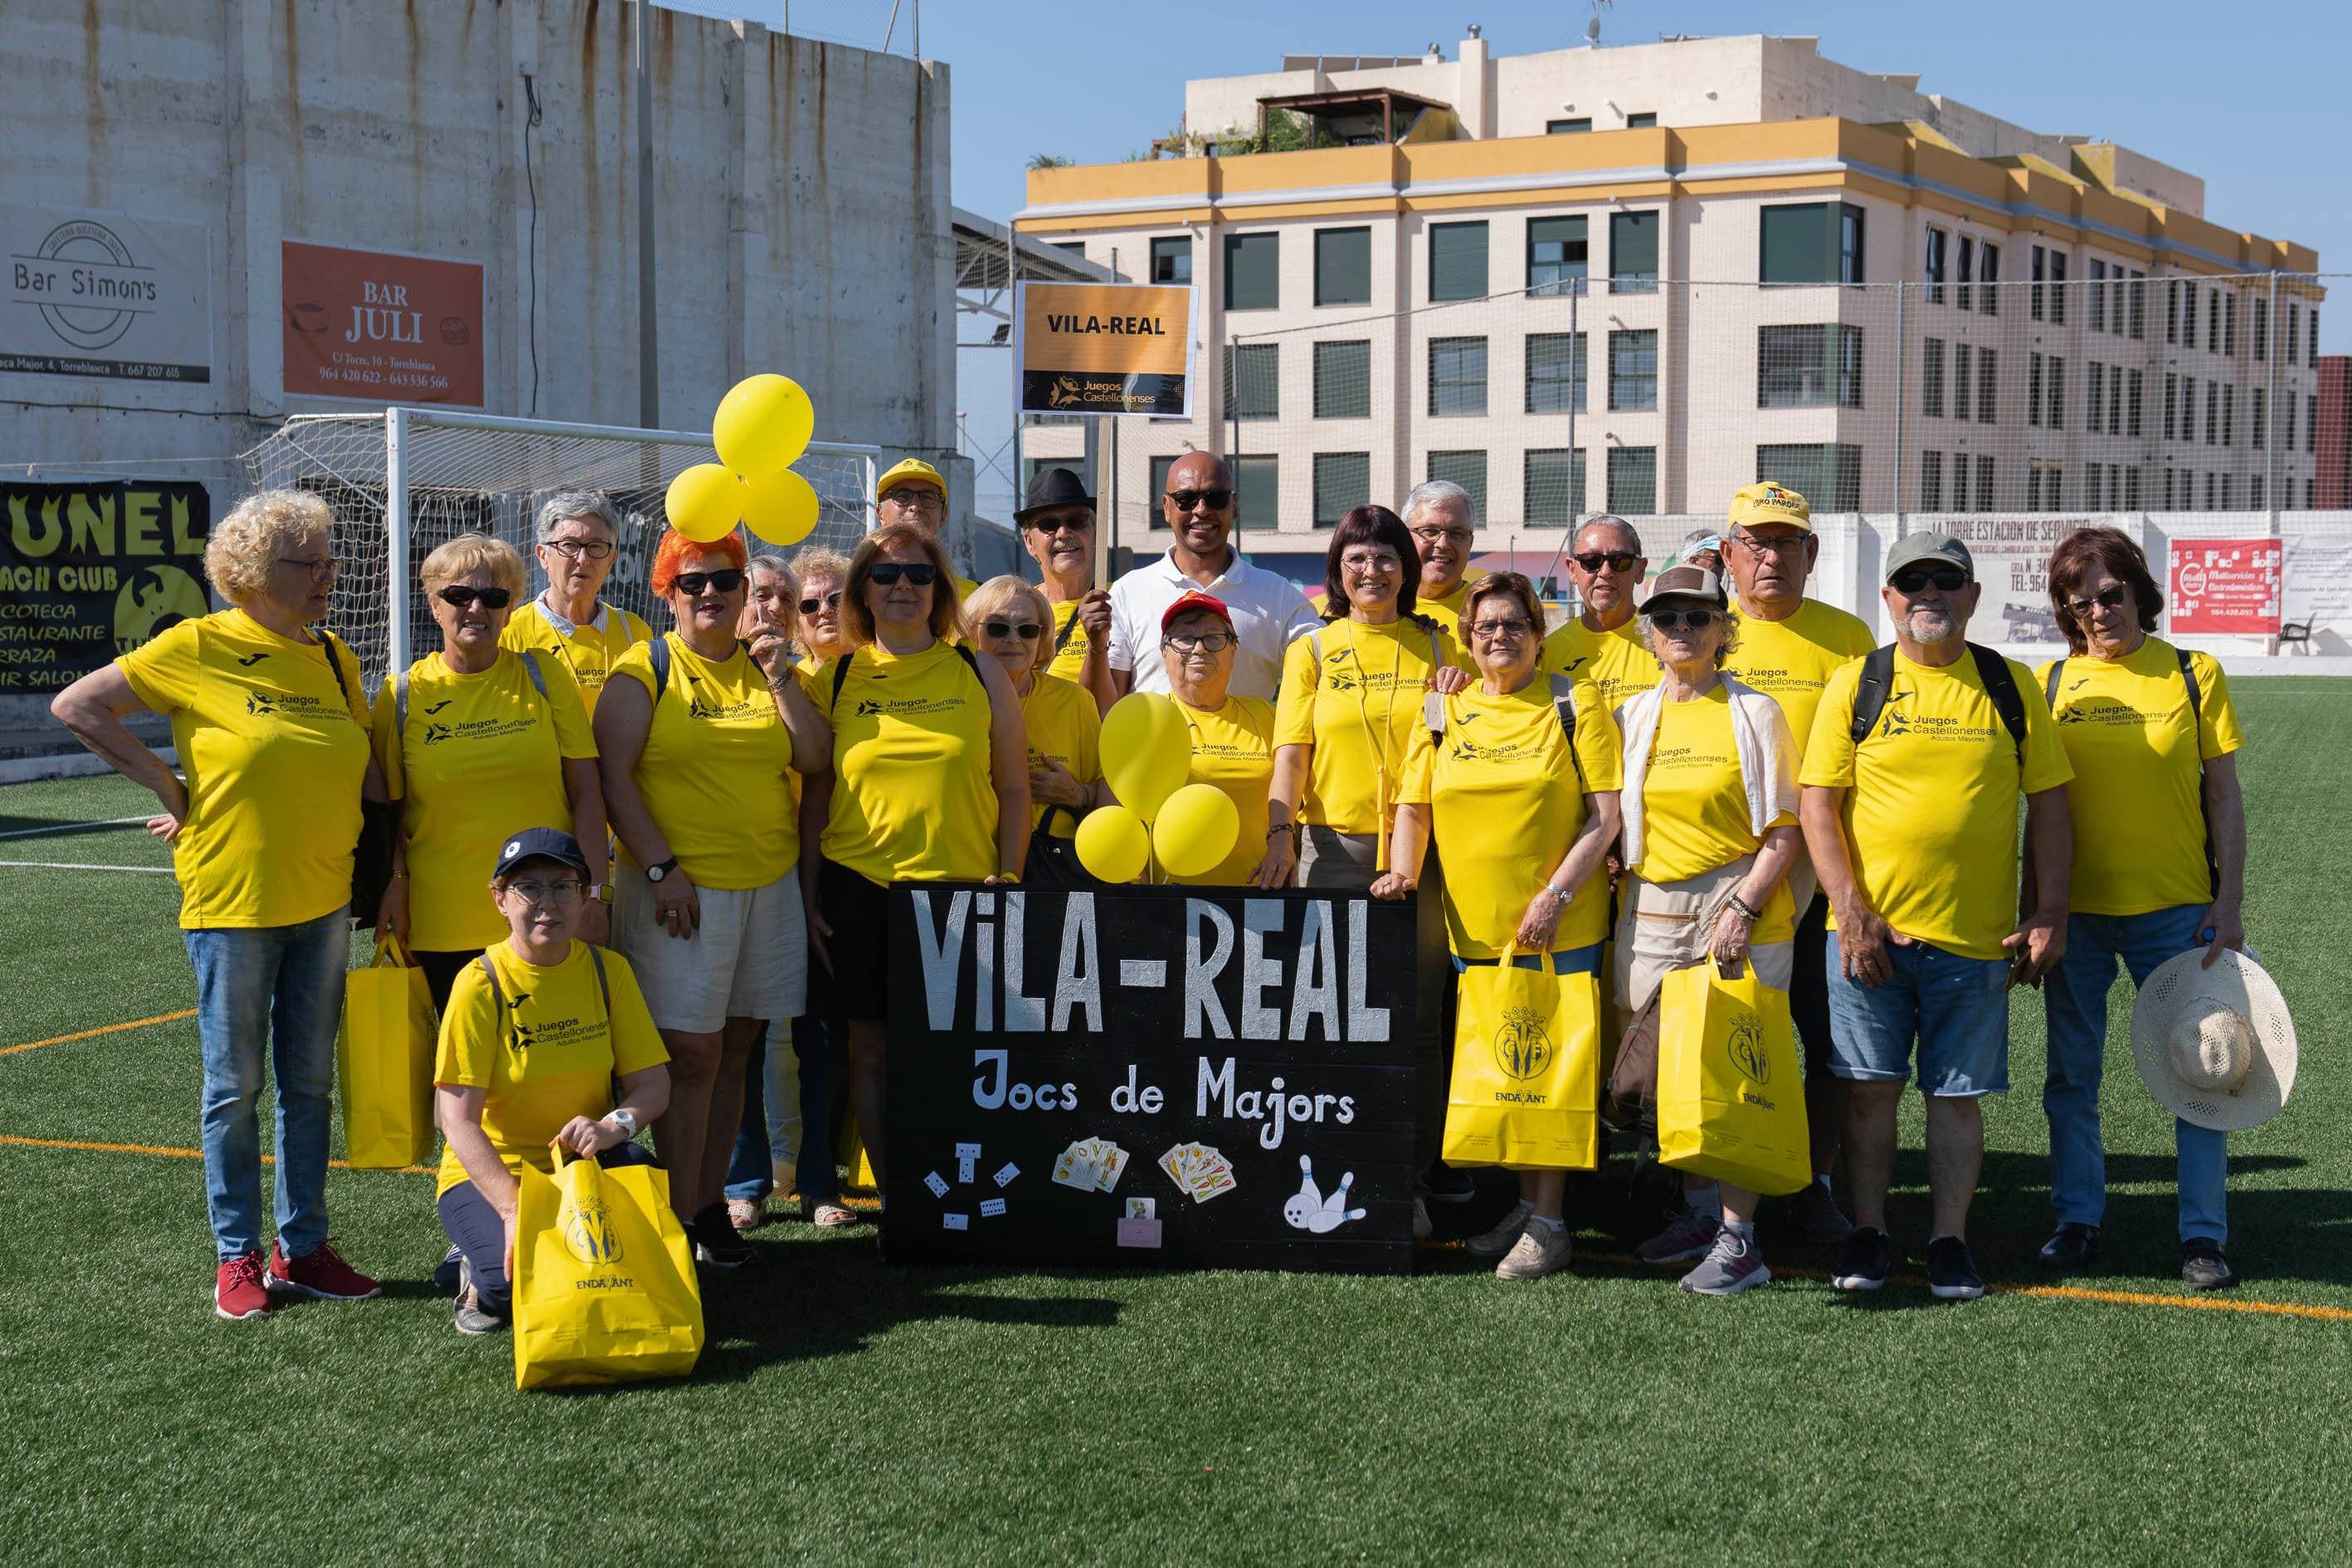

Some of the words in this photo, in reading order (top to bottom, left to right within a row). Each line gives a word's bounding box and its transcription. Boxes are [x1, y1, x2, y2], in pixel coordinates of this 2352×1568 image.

[15, 263, 56, 292] Bar
[72, 269, 156, 300] Simon's
[363, 281, 409, 306] BAR
[345, 305, 423, 343] JULI
[1047, 314, 1166, 335] VILA-REAL
[59, 359, 110, 374] Torreblanca
[373, 356, 382, 366] 10
[390, 357, 436, 371] Torreblanca
[1083, 380, 1122, 393] Juegos
[1083, 392, 1156, 403] Castellonenses
[2028, 521, 2038, 540] DE
[58, 566, 118, 592] CLUB
[2029, 575, 2047, 592] 964
[1359, 671, 1399, 680] Juegos
[1746, 668, 1788, 678] Juegos
[1599, 677, 1621, 687] egos
[1746, 677, 1825, 689] Castellonenses
[278, 694, 320, 705] Juegos
[886, 699, 966, 713] Castellonenses
[887, 698, 928, 707] Juegos
[713, 702, 750, 713] Juegos
[2091, 705, 2134, 714] Juegos
[455, 718, 498, 730] Juegos
[1914, 715, 1958, 726] Juegos
[455, 718, 537, 738] Castellonenses
[1913, 724, 1997, 736] Castellonenses
[1655, 747, 1691, 757] Juegos
[1653, 756, 1727, 765] Castellonenses
[535, 1017, 579, 1033] Juegos
[972, 1049, 1078, 1110] Jocs
[1110, 1064, 1164, 1114] de
[1195, 1056, 1355, 1150] Majors
[1496, 1089, 1547, 1106] ENDAVANT
[576, 1274, 634, 1292] ENDAVANT
